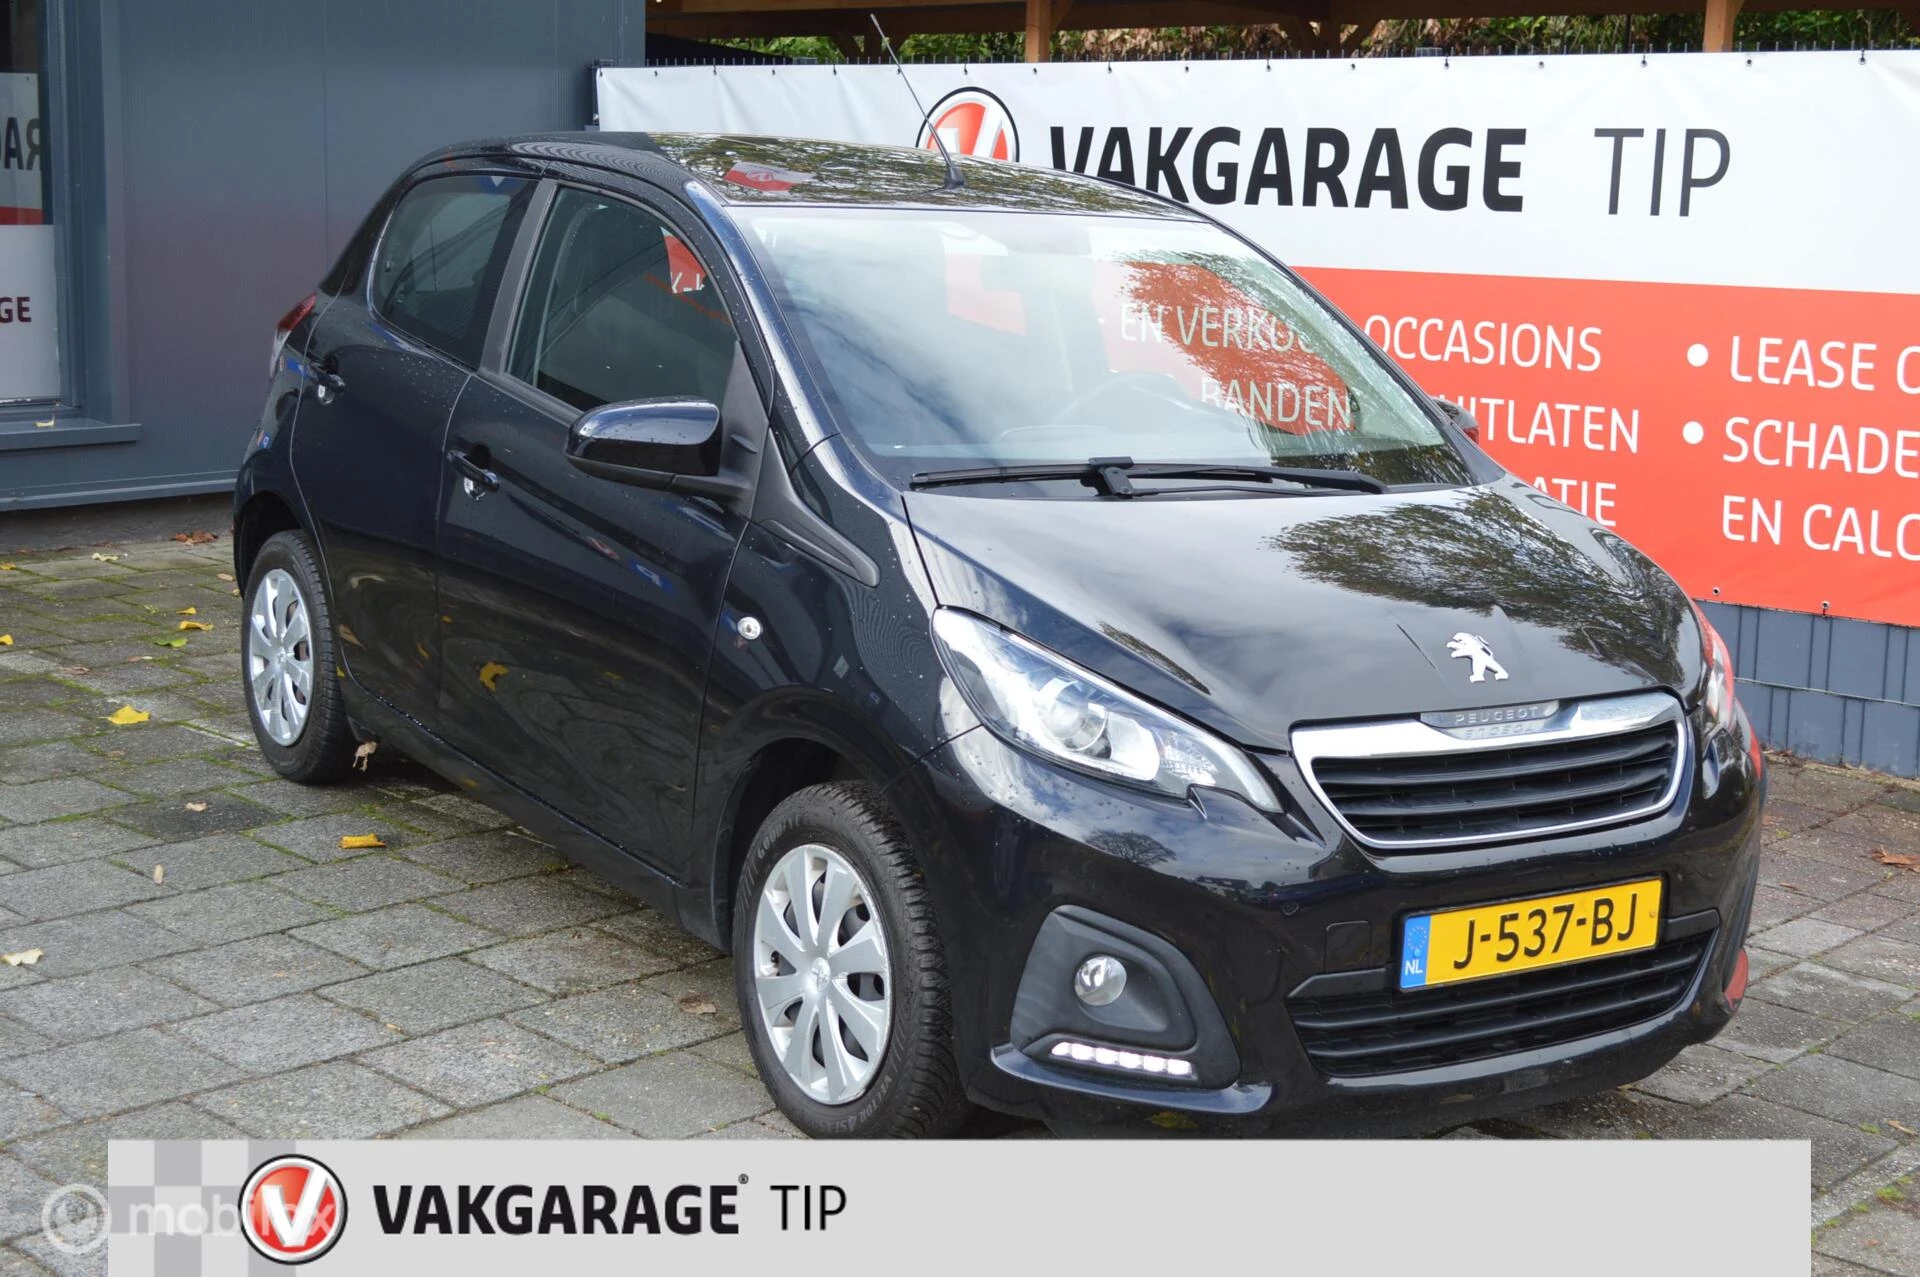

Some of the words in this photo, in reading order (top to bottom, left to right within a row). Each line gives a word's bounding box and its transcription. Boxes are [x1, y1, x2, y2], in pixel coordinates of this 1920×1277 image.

[1050, 126, 1527, 213] VAKGARAGE
[1594, 127, 1731, 217] TIP
[1121, 303, 1163, 344] EN
[1364, 315, 1602, 372] OCCASIONS
[1730, 336, 1877, 391] LEASE
[1723, 416, 1920, 479] SCHADE
[1722, 495, 1782, 546] EN
[1455, 706, 1539, 726] PEUGEOT
[1453, 893, 1639, 970] J-537-BJ
[1405, 959, 1424, 976] NL
